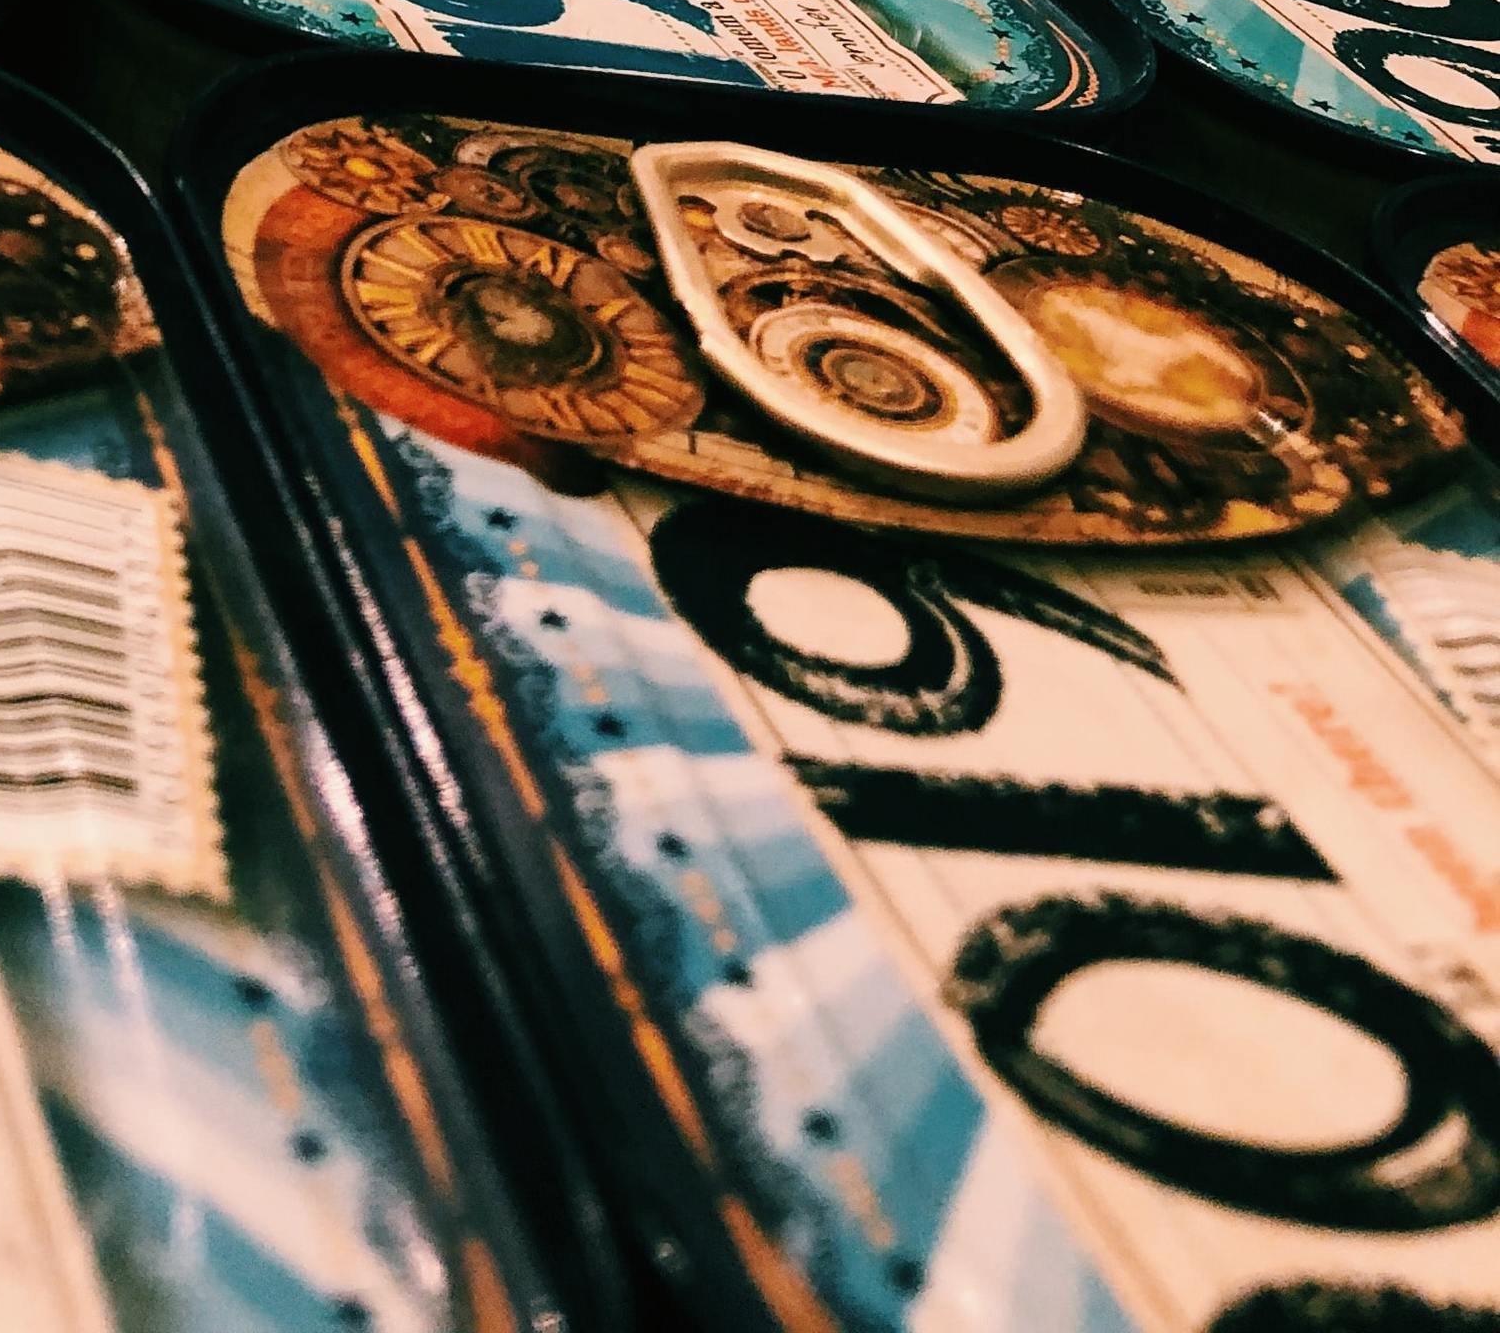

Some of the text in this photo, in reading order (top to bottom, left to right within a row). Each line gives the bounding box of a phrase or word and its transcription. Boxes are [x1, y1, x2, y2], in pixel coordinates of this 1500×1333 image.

[745, 10, 804, 54] lands
[795, 4, 886, 67] Jennifer
[648, 495, 1500, 1333] 019
